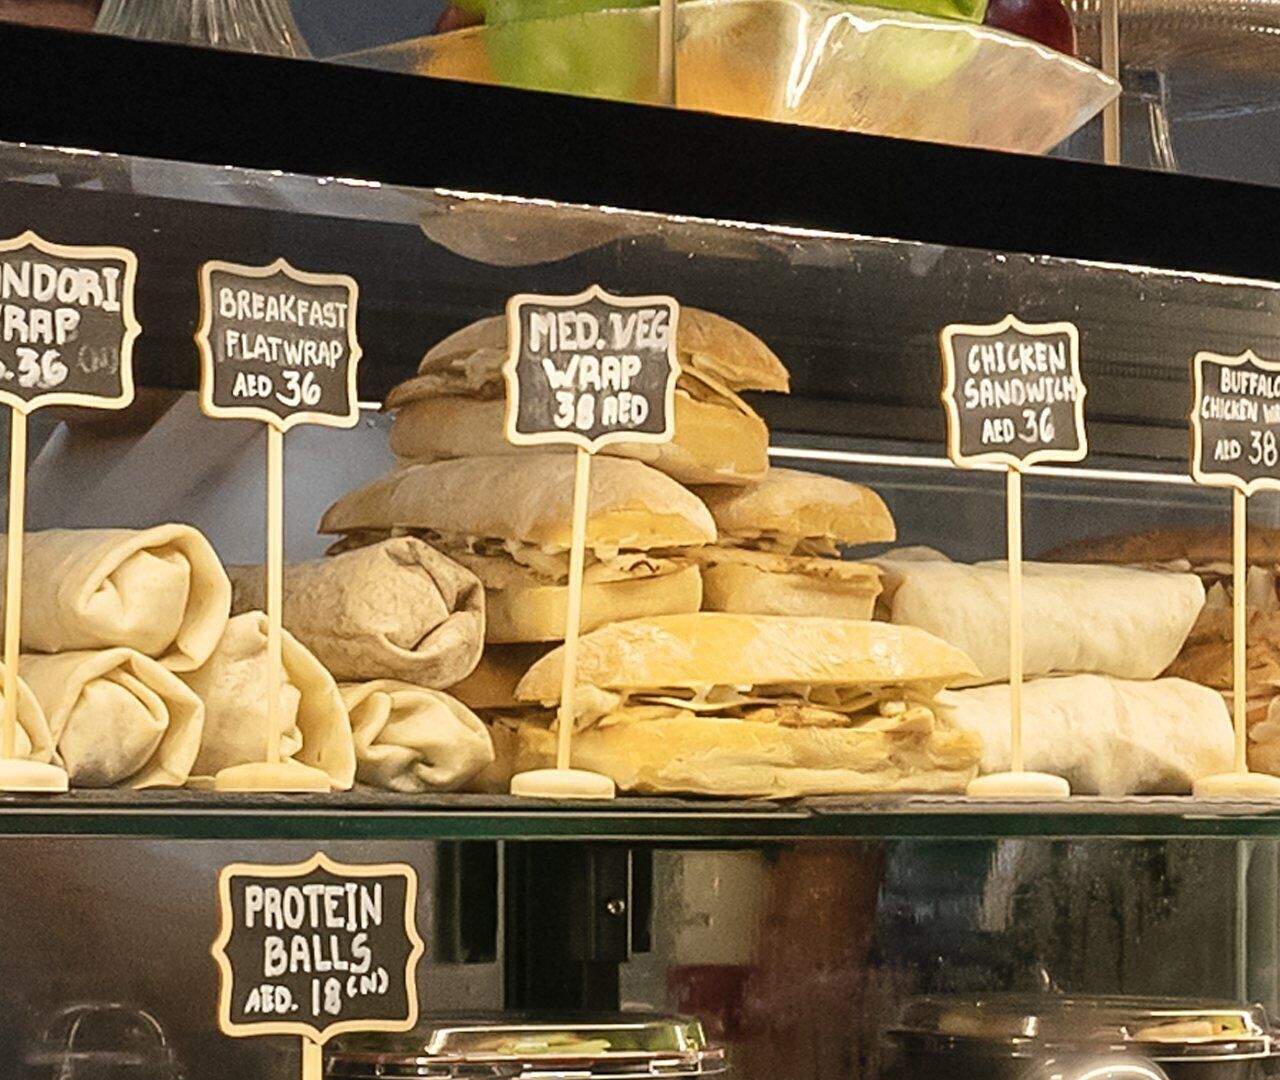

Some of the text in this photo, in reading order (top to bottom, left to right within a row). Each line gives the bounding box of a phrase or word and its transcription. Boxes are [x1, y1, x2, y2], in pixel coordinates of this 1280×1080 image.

[220, 287, 348, 328] BREAKFAST
[530, 309, 670, 351] MED. VEG
[16, 347, 69, 389] 36
[542, 354, 641, 391] WRAP
[968, 341, 1066, 375] CHICKEN
[232, 370, 321, 407] AED 36
[964, 375, 1078, 409] SANDWICH
[601, 391, 649, 426] AED
[982, 407, 1055, 444] AED 36
[1201, 395, 1258, 423] CHICKEN
[1248, 430, 1279, 467] 38
[244, 883, 383, 932] PROTEIN
[264, 932, 372, 977] BALLS
[244, 967, 389, 1016] AED. 18 (N)
